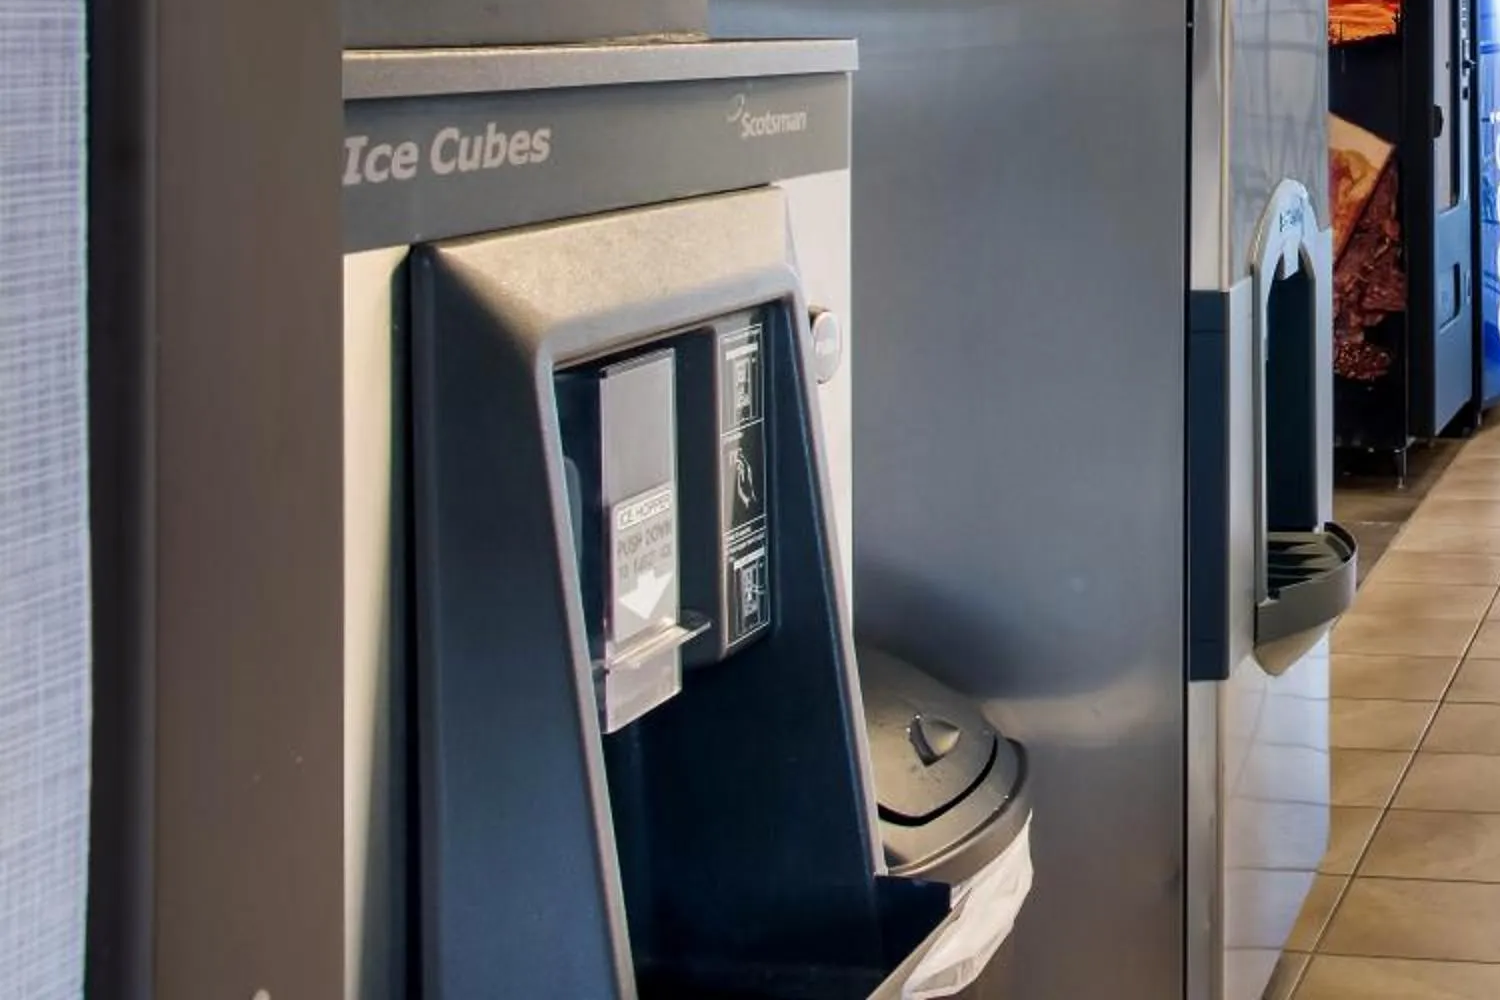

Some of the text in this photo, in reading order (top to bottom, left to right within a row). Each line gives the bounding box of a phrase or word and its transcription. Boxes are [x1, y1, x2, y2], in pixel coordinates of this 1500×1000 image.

[741, 109, 807, 138] Scotsman
[342, 122, 550, 186] Ice Cubes
